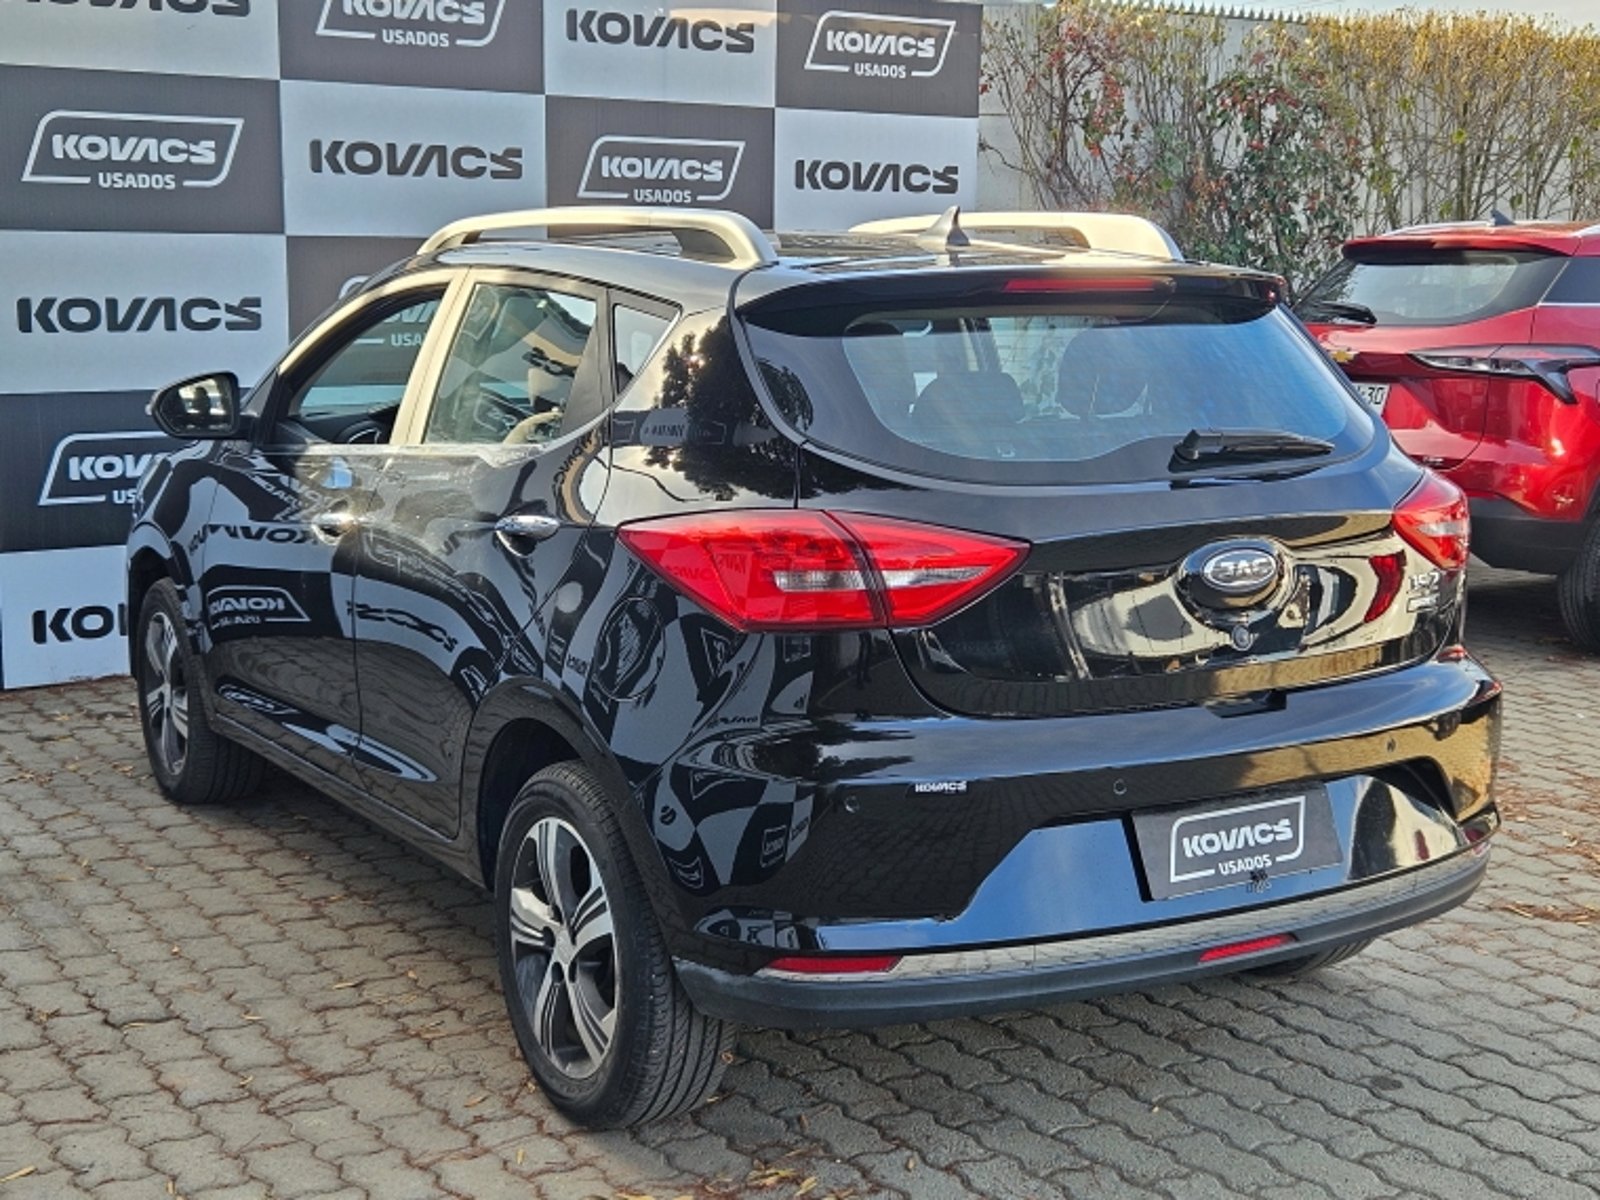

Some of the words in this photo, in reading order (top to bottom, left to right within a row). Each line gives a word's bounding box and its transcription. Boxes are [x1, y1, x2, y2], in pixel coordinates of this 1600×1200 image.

[382, 29, 449, 47] USADOS
[566, 9, 755, 54] KOVACS
[826, 30, 936, 58] KOVACS
[854, 63, 906, 79] USADOS
[51, 134, 216, 165] KOVACS
[310, 139, 523, 180] KOVACS
[98, 172, 176, 190] USADOS
[601, 156, 723, 182] KOVACS
[794, 159, 959, 194] KOVACS
[633, 188, 692, 204] USADOS
[16, 297, 262, 334] KOVACS
[390, 333, 423, 347] USA
[68, 454, 153, 481] KOV
[1182, 818, 1294, 859] KOVACS
[1218, 853, 1273, 878] USADOS
